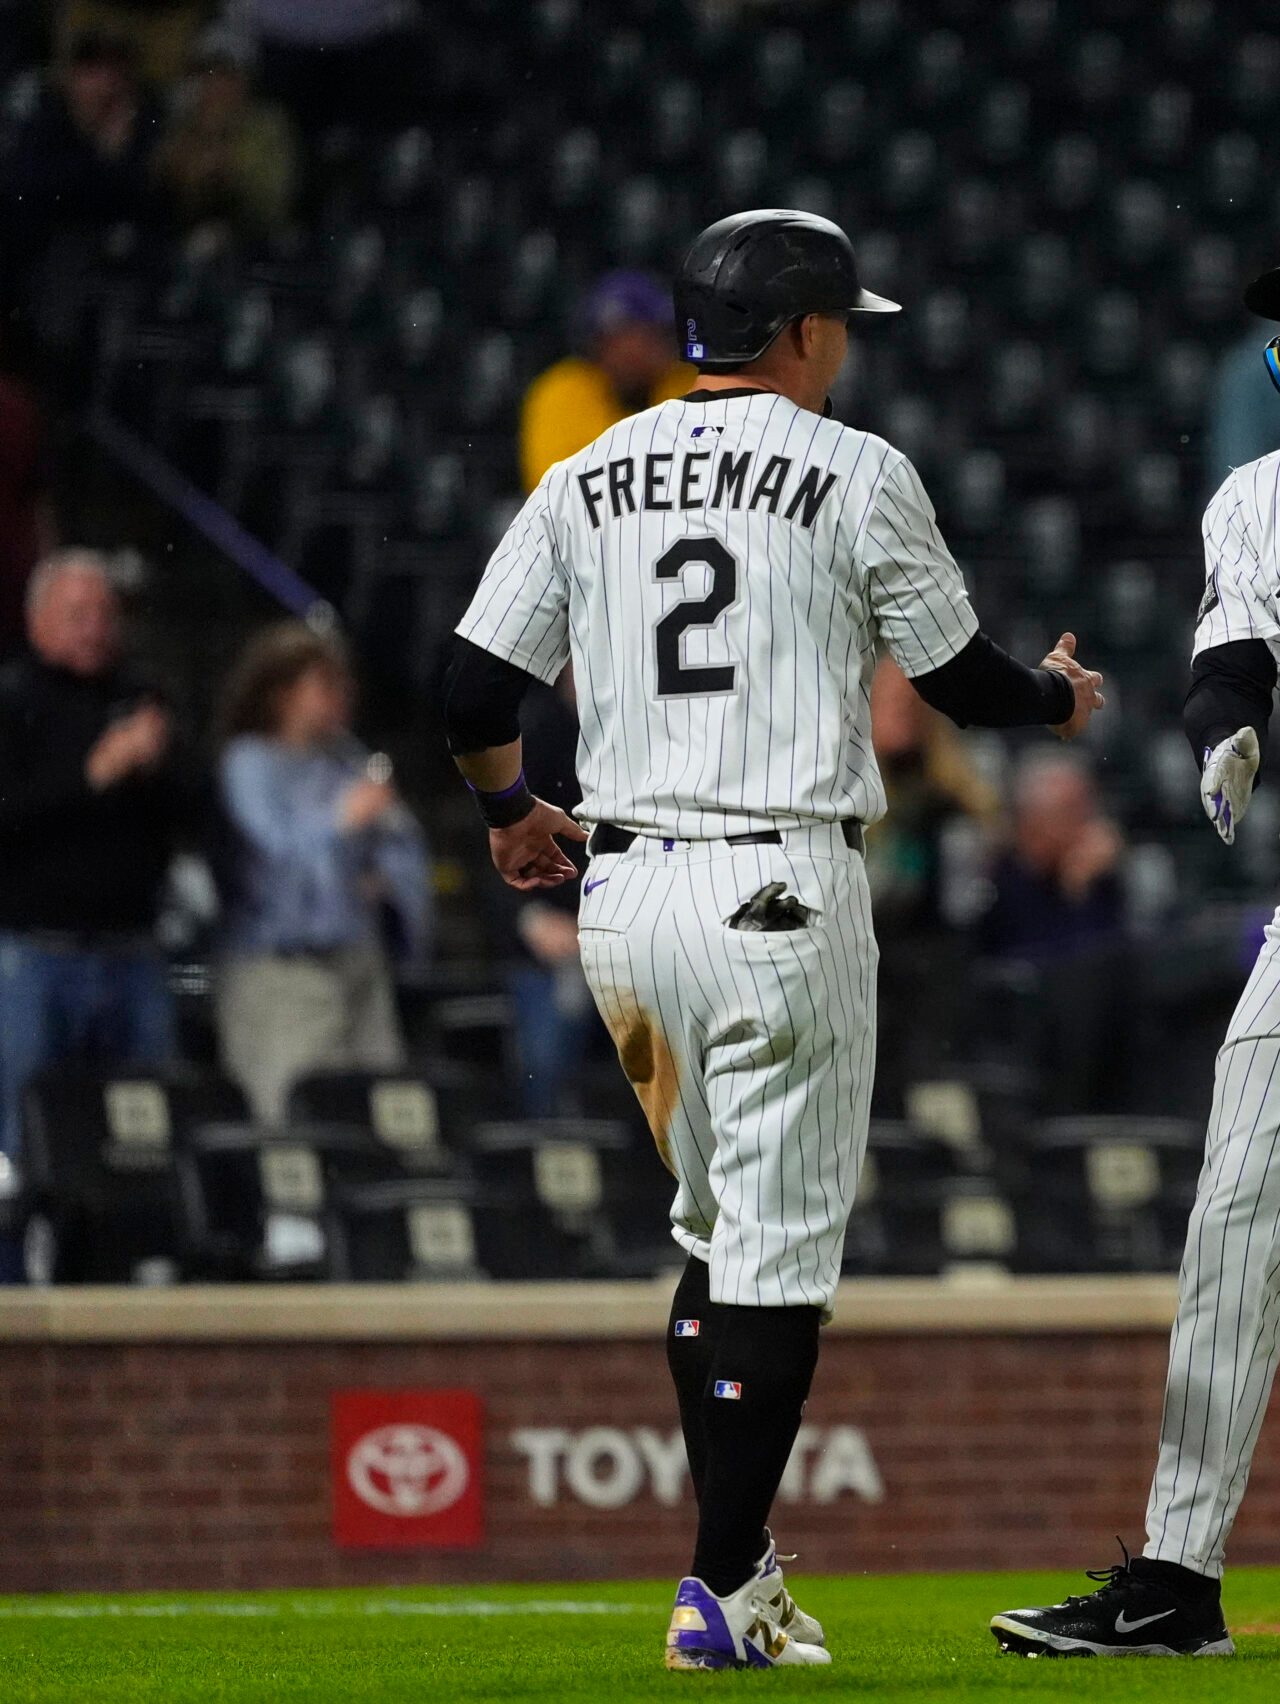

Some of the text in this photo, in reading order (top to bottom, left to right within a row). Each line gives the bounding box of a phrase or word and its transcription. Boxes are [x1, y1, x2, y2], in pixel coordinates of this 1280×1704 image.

[686, 318, 698, 341] 2
[577, 451, 841, 532] FREEMAN
[651, 532, 741, 701] 2
[509, 1423, 886, 1509] TOYTA
